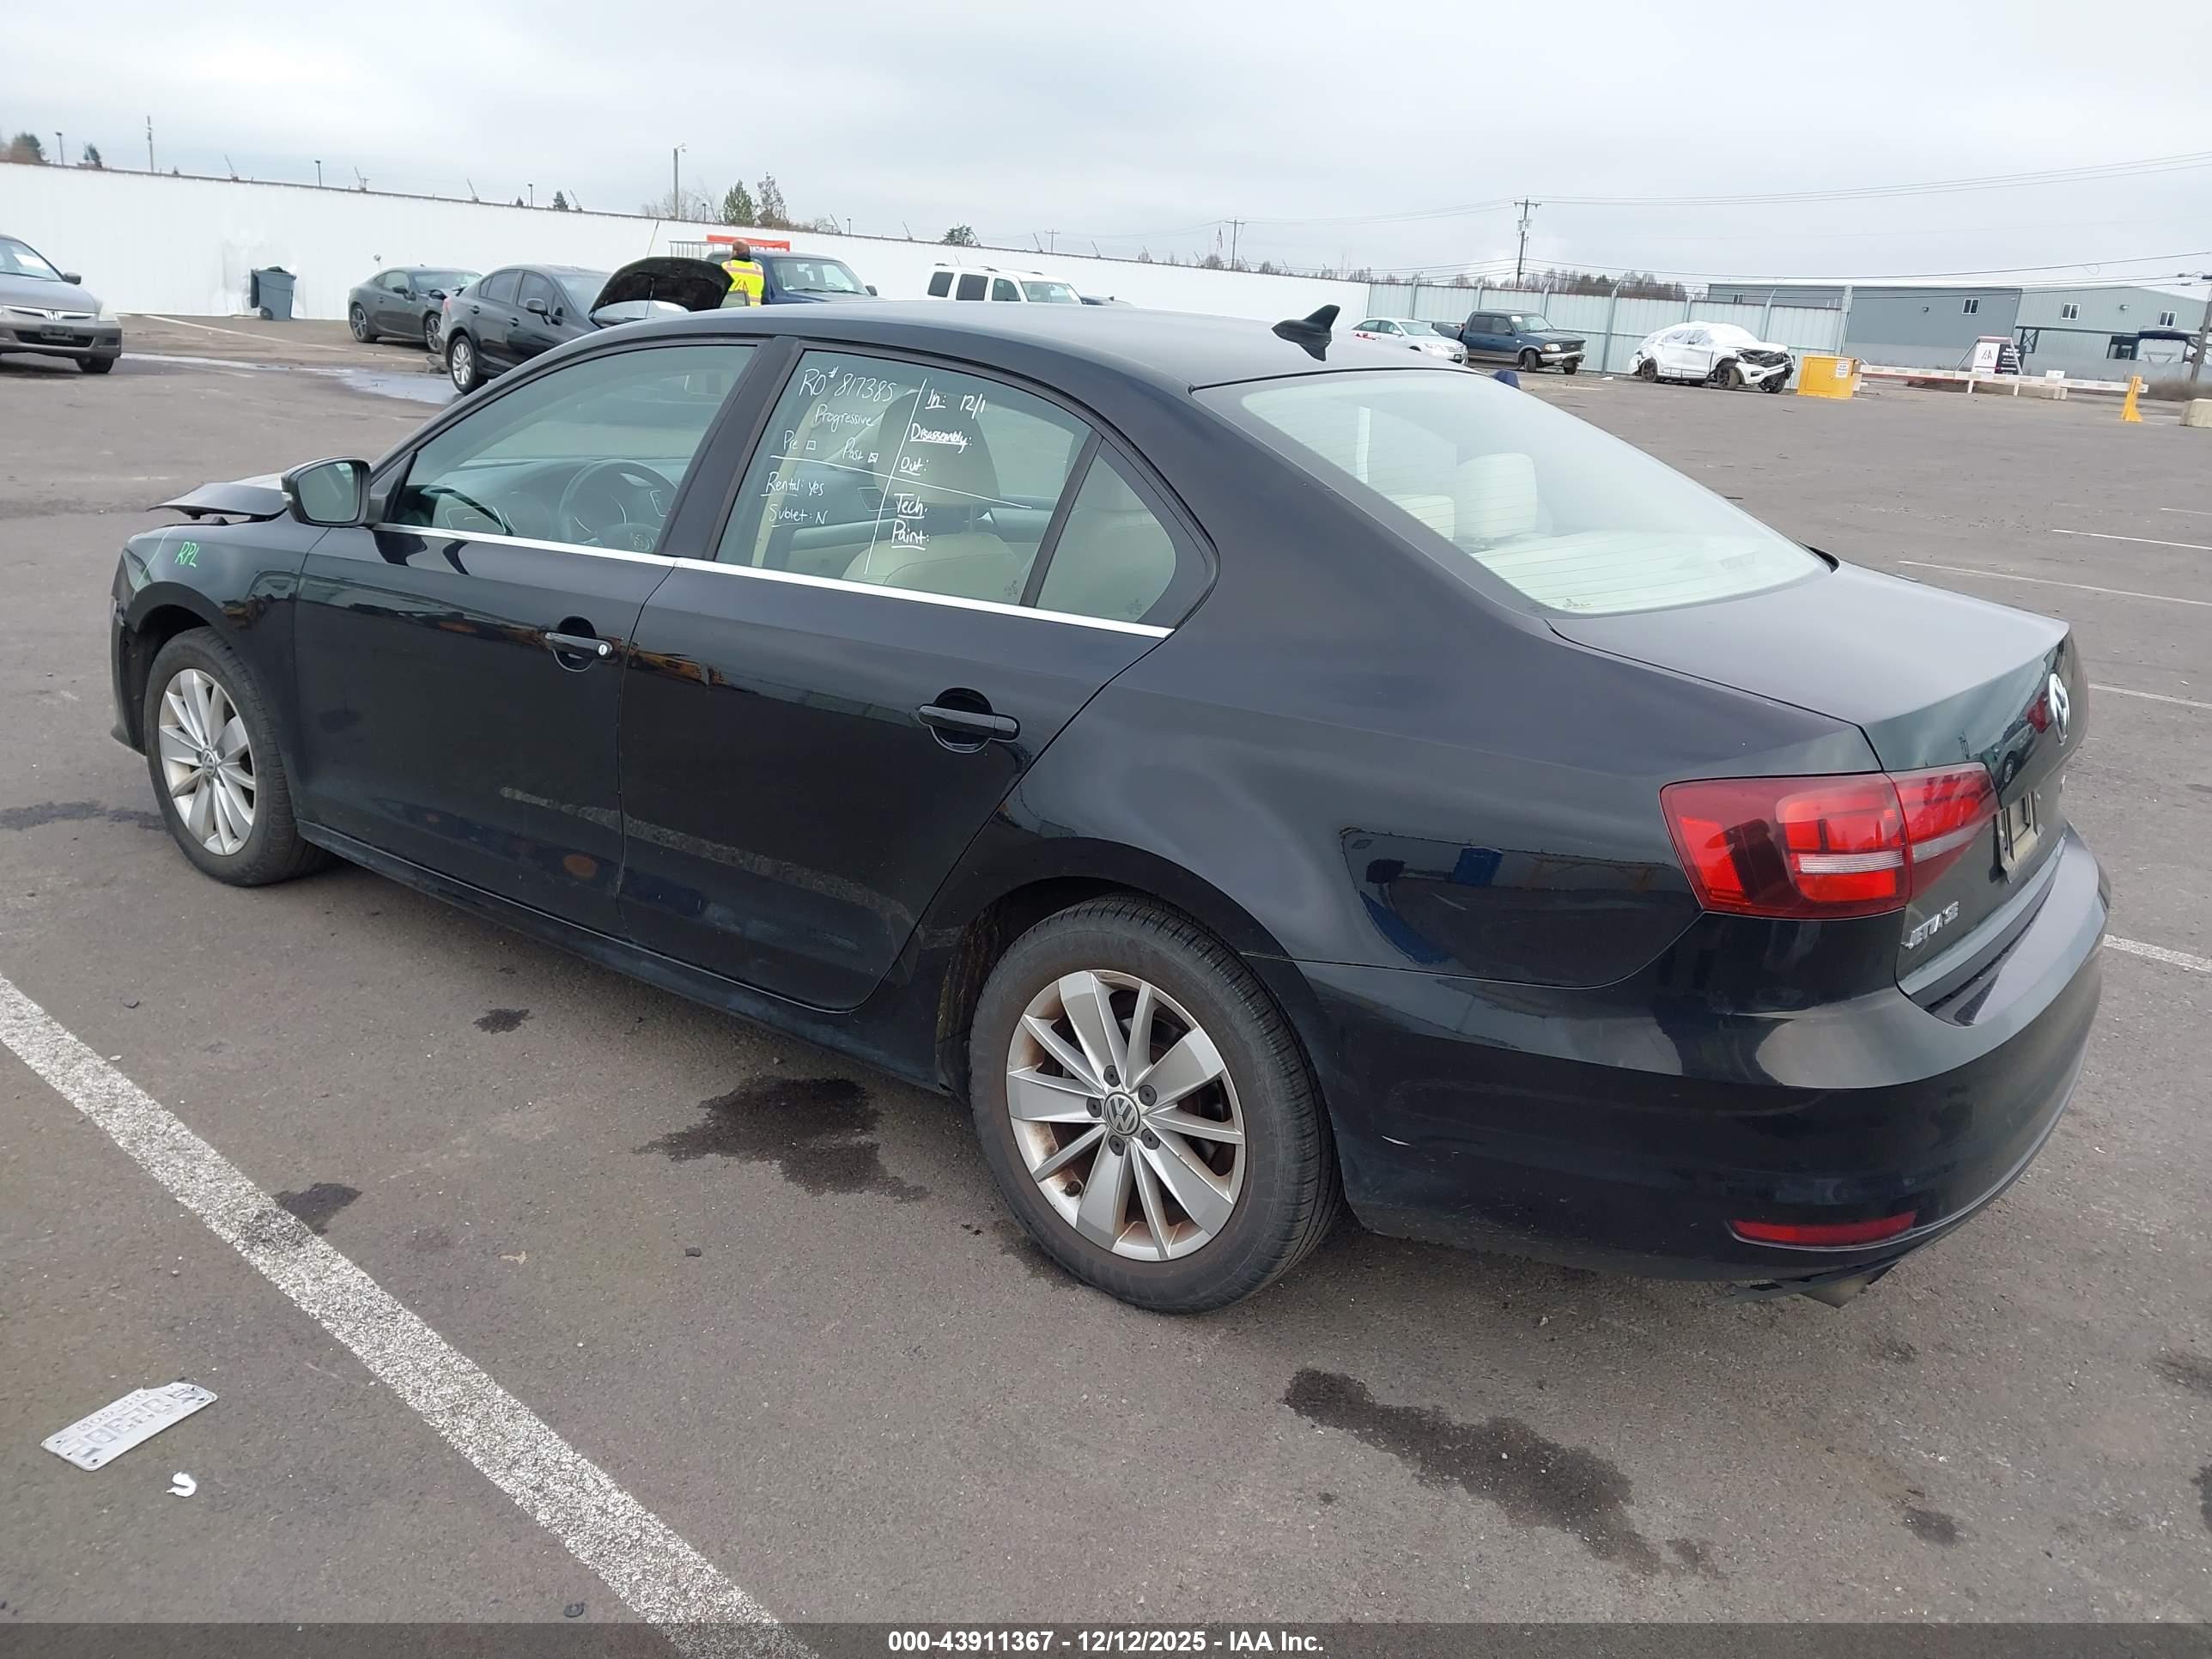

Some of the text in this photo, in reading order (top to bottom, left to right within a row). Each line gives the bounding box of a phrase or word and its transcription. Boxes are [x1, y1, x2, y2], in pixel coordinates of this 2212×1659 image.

[834, 373, 898, 403] 817385
[813, 404, 875, 432] Progressive
[959, 393, 987, 419] 12/1
[782, 430, 798, 450] Pre
[815, 510, 829, 526] N
[174, 541, 199, 568] RPL
